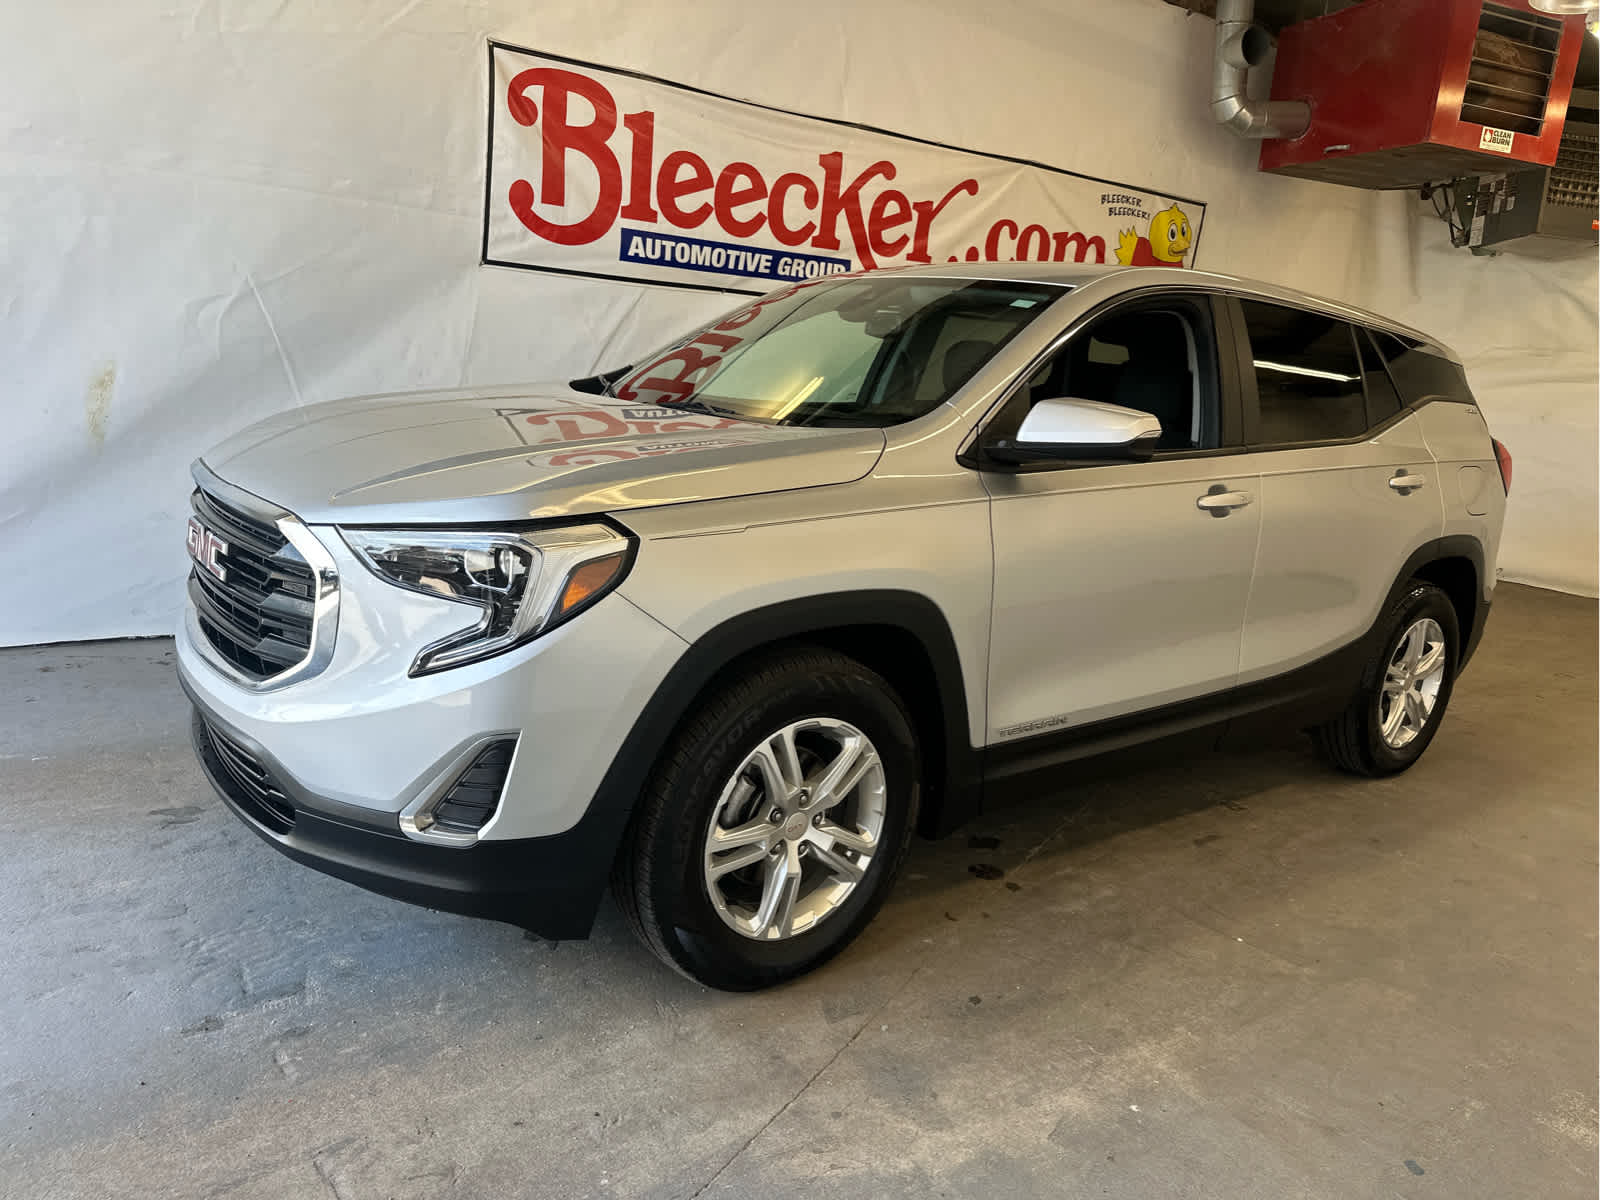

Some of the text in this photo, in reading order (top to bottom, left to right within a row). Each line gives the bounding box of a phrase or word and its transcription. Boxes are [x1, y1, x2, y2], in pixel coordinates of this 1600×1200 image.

[1493, 130, 1512, 139] CLEAN
[1492, 137, 1511, 146] BURN
[1101, 194, 1142, 207] BLEECKER
[1108, 207, 1151, 220] BLEECKER!
[627, 235, 773, 274] AUTOMOTIVE
[187, 517, 229, 582] GMC
